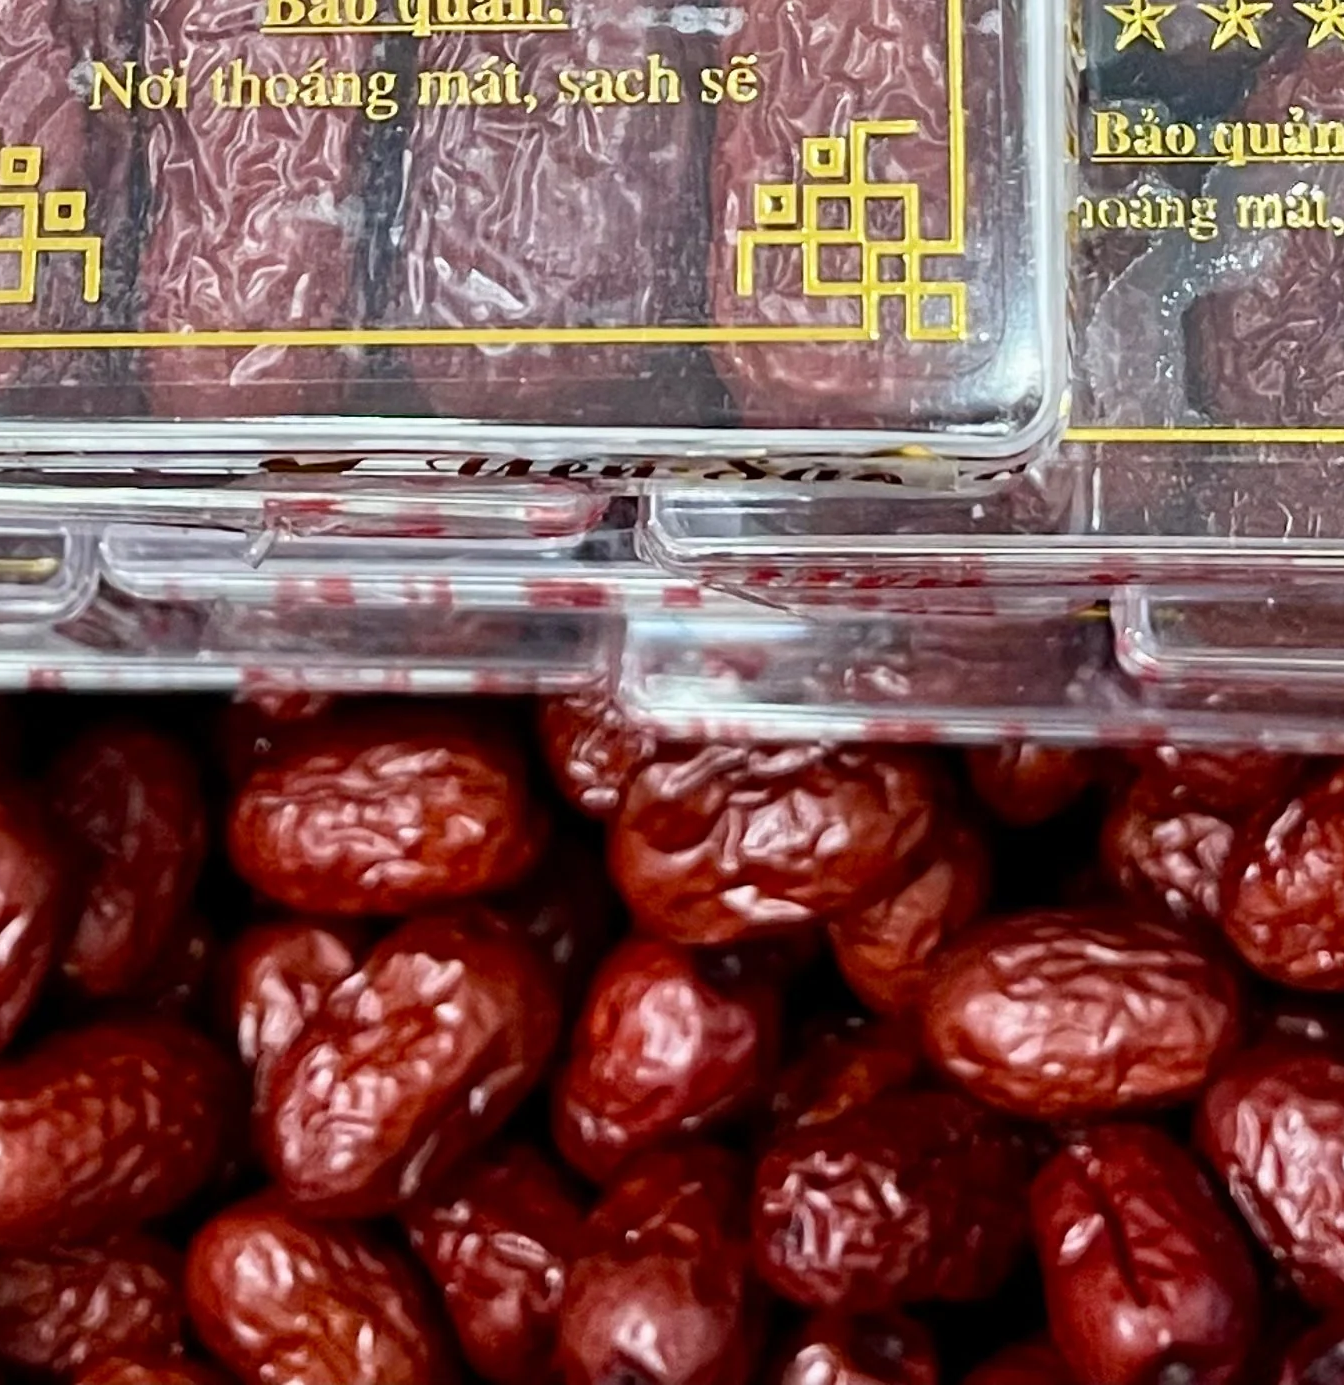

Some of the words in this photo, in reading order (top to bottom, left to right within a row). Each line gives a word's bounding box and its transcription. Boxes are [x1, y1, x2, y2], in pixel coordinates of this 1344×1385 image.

[90, 46, 189, 110] Nơi
[211, 54, 398, 119] thoáng
[419, 54, 537, 111] mát,
[558, 53, 680, 115] sạch
[701, 54, 759, 104] sẽ
[1093, 107, 1197, 157] Bảo
